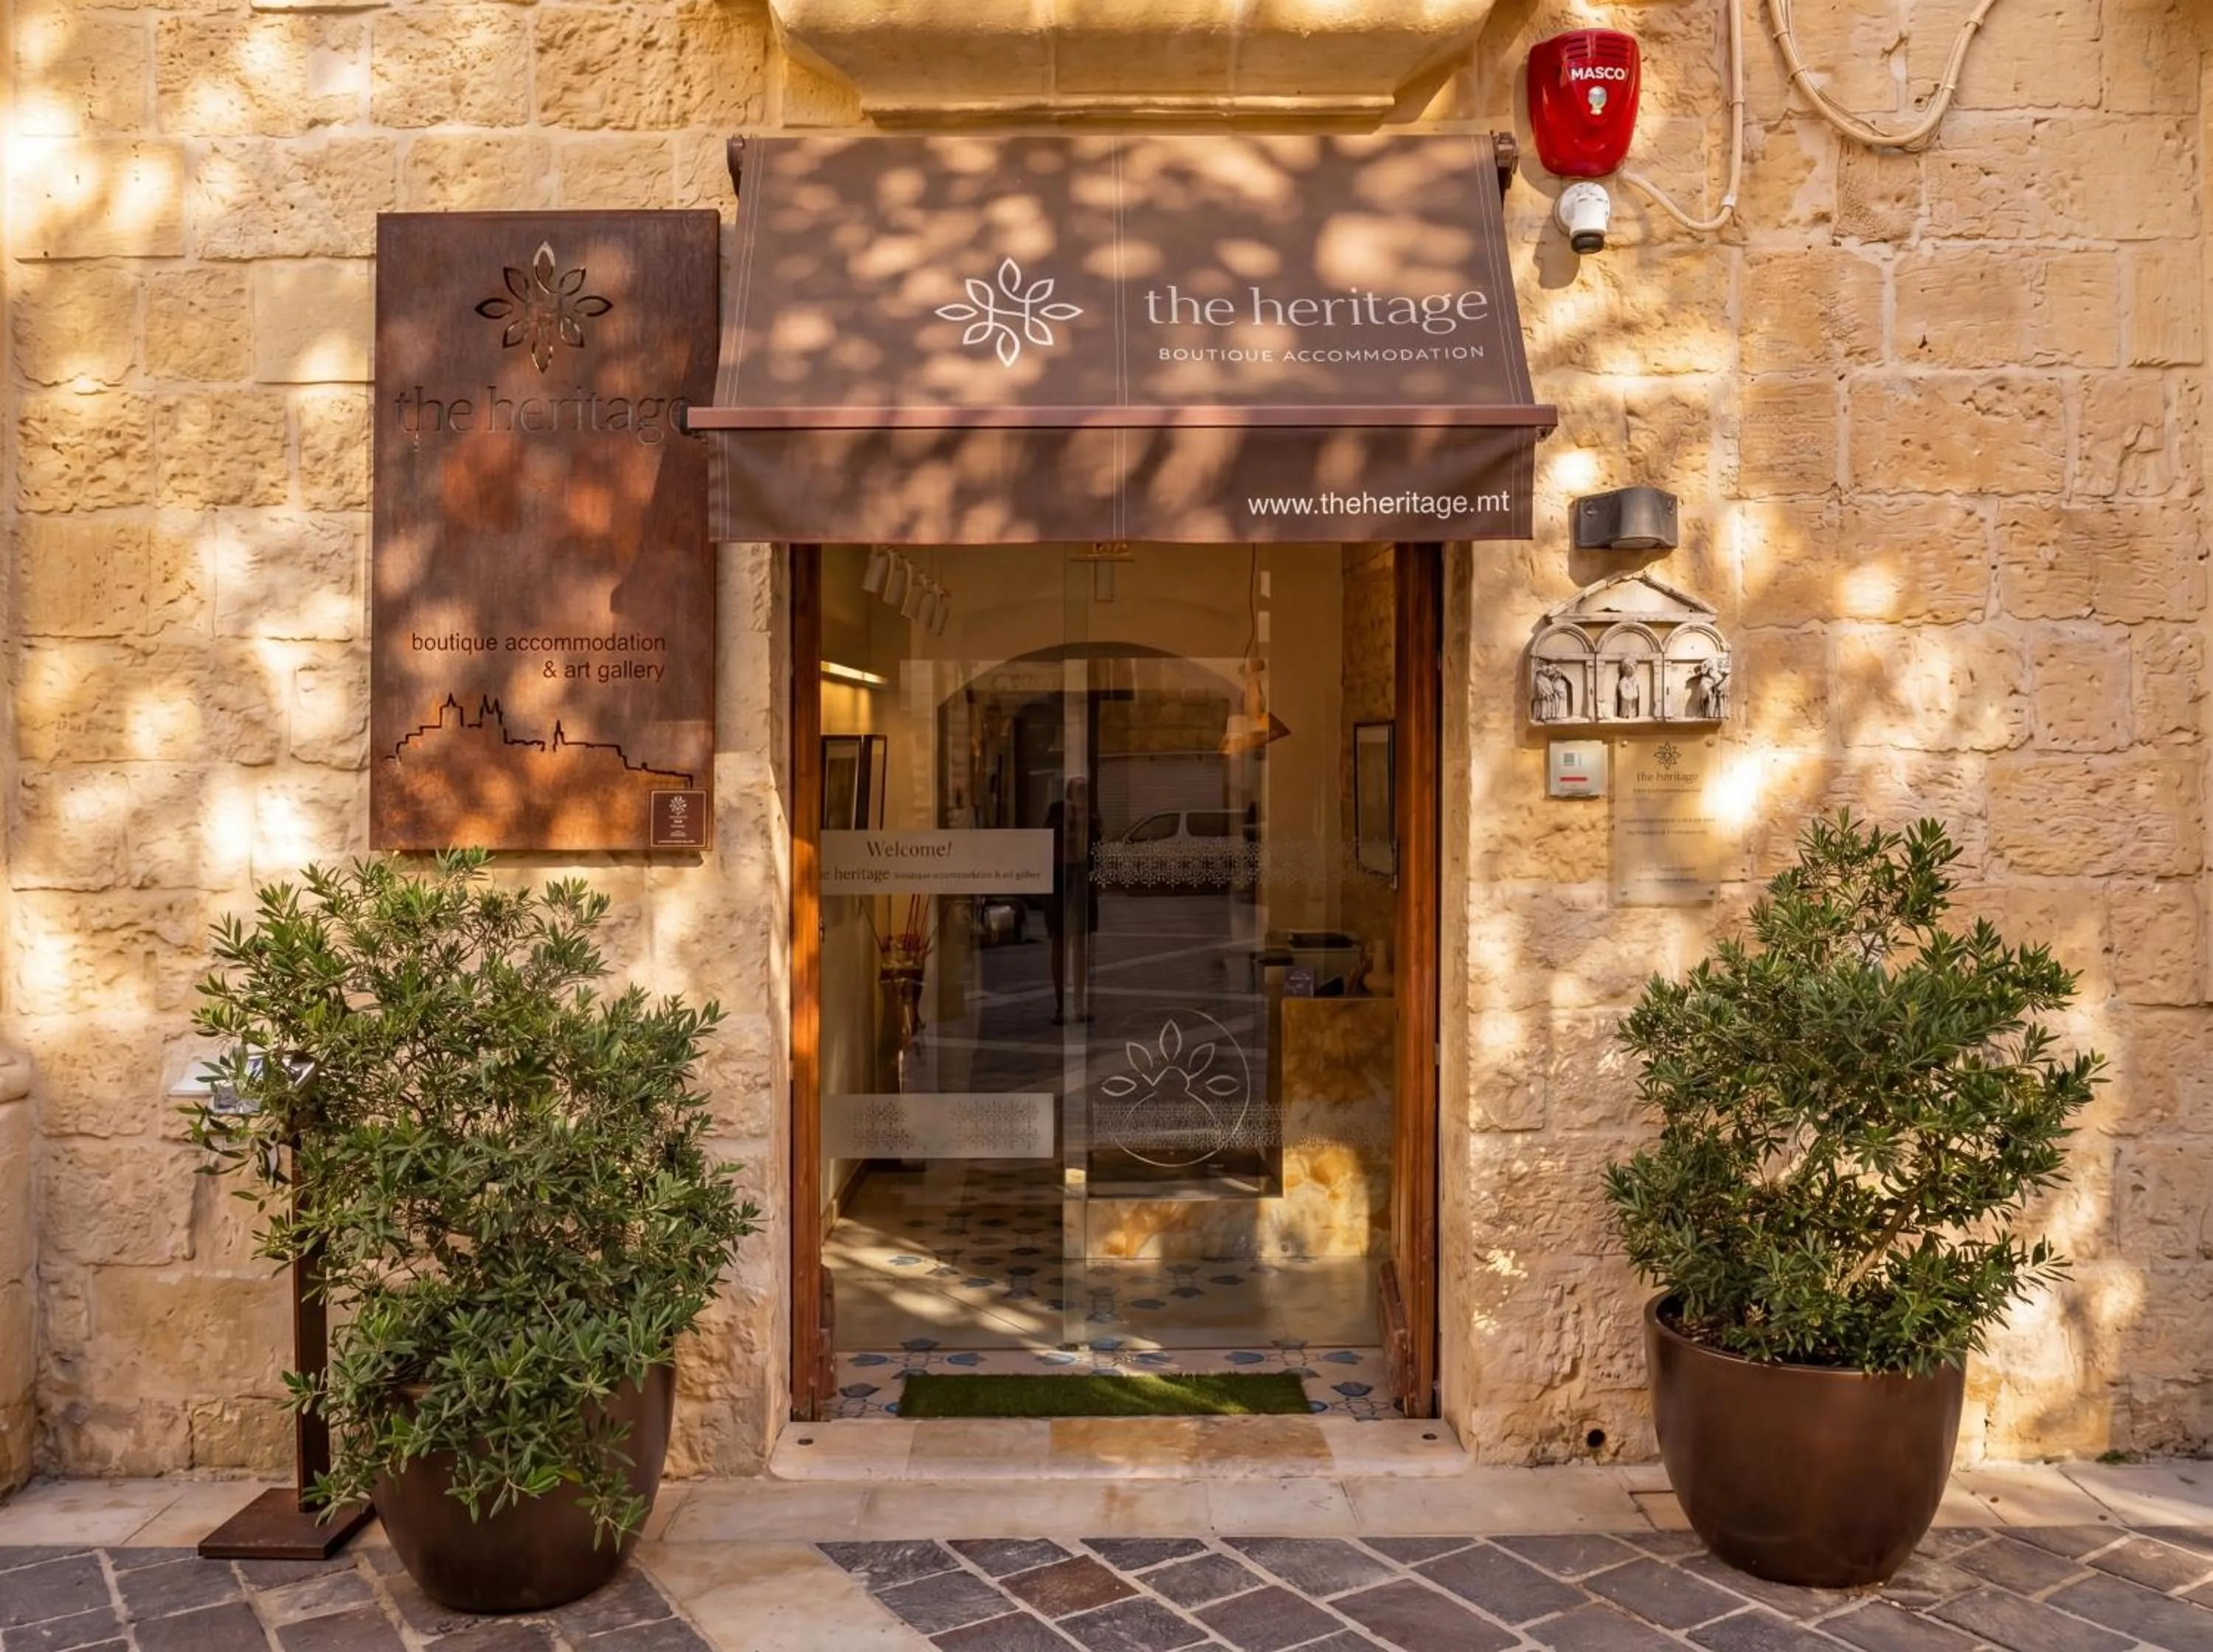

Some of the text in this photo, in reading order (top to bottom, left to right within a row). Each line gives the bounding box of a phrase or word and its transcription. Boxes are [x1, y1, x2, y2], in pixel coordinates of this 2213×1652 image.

[1570, 66, 1626, 80] MASCO
[1144, 285, 1489, 335] the heritage
[1159, 345, 1485, 363] BOUTIQUE ACCOMMODATION
[393, 385, 474, 434] the
[1247, 490, 1510, 519] www.theheritage.mt
[412, 632, 666, 656] boutique accommodation
[542, 660, 665, 683] & art gallery
[866, 840, 953, 858] Welcome!
[834, 867, 890, 884] heritage
